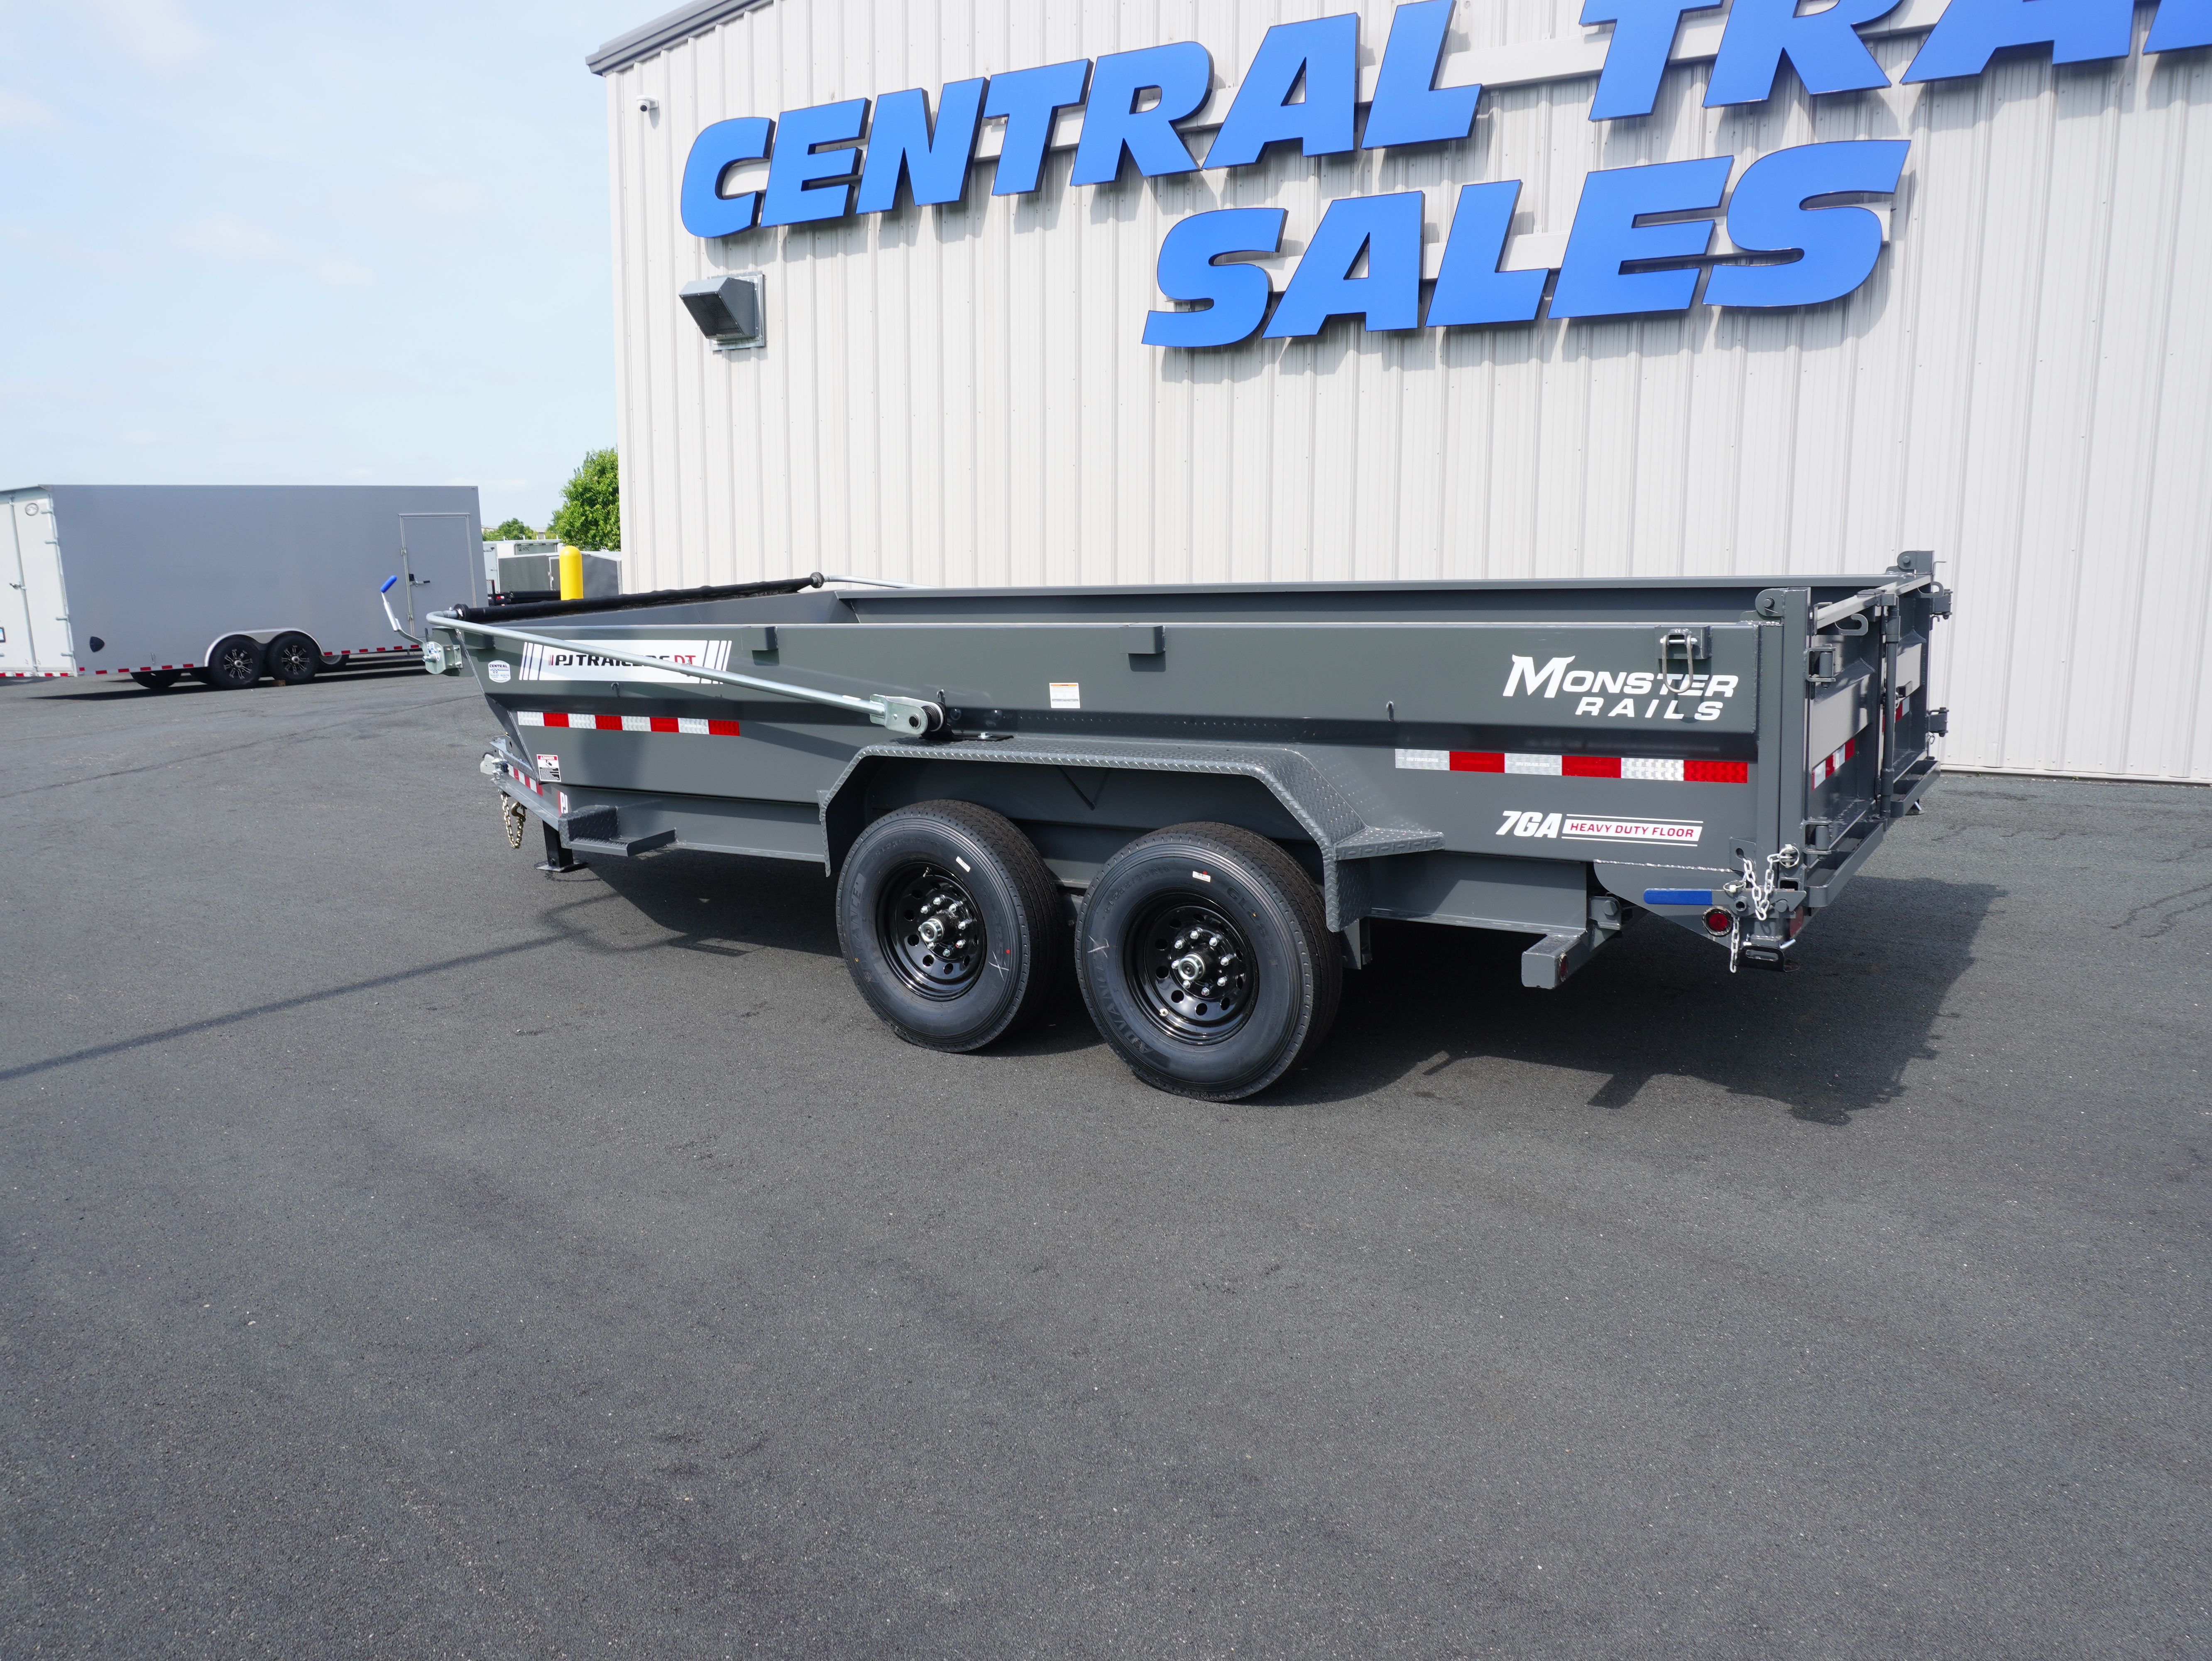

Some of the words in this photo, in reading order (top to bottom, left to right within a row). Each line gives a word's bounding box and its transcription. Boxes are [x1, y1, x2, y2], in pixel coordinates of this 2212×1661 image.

[681, 0, 1482, 238] CENTRAL
[1579, 0, 2212, 121] TRA
[1142, 140, 1911, 348] SALES
[674, 655, 696, 665] DT
[1502, 654, 1738, 698] MONSTER
[1575, 697, 1723, 720] RAILS
[1496, 811, 1562, 838] 7GA
[1570, 823, 1612, 833] HEAVY
[1615, 825, 1649, 835] DUTY
[1652, 827, 1694, 838] FLOOR
